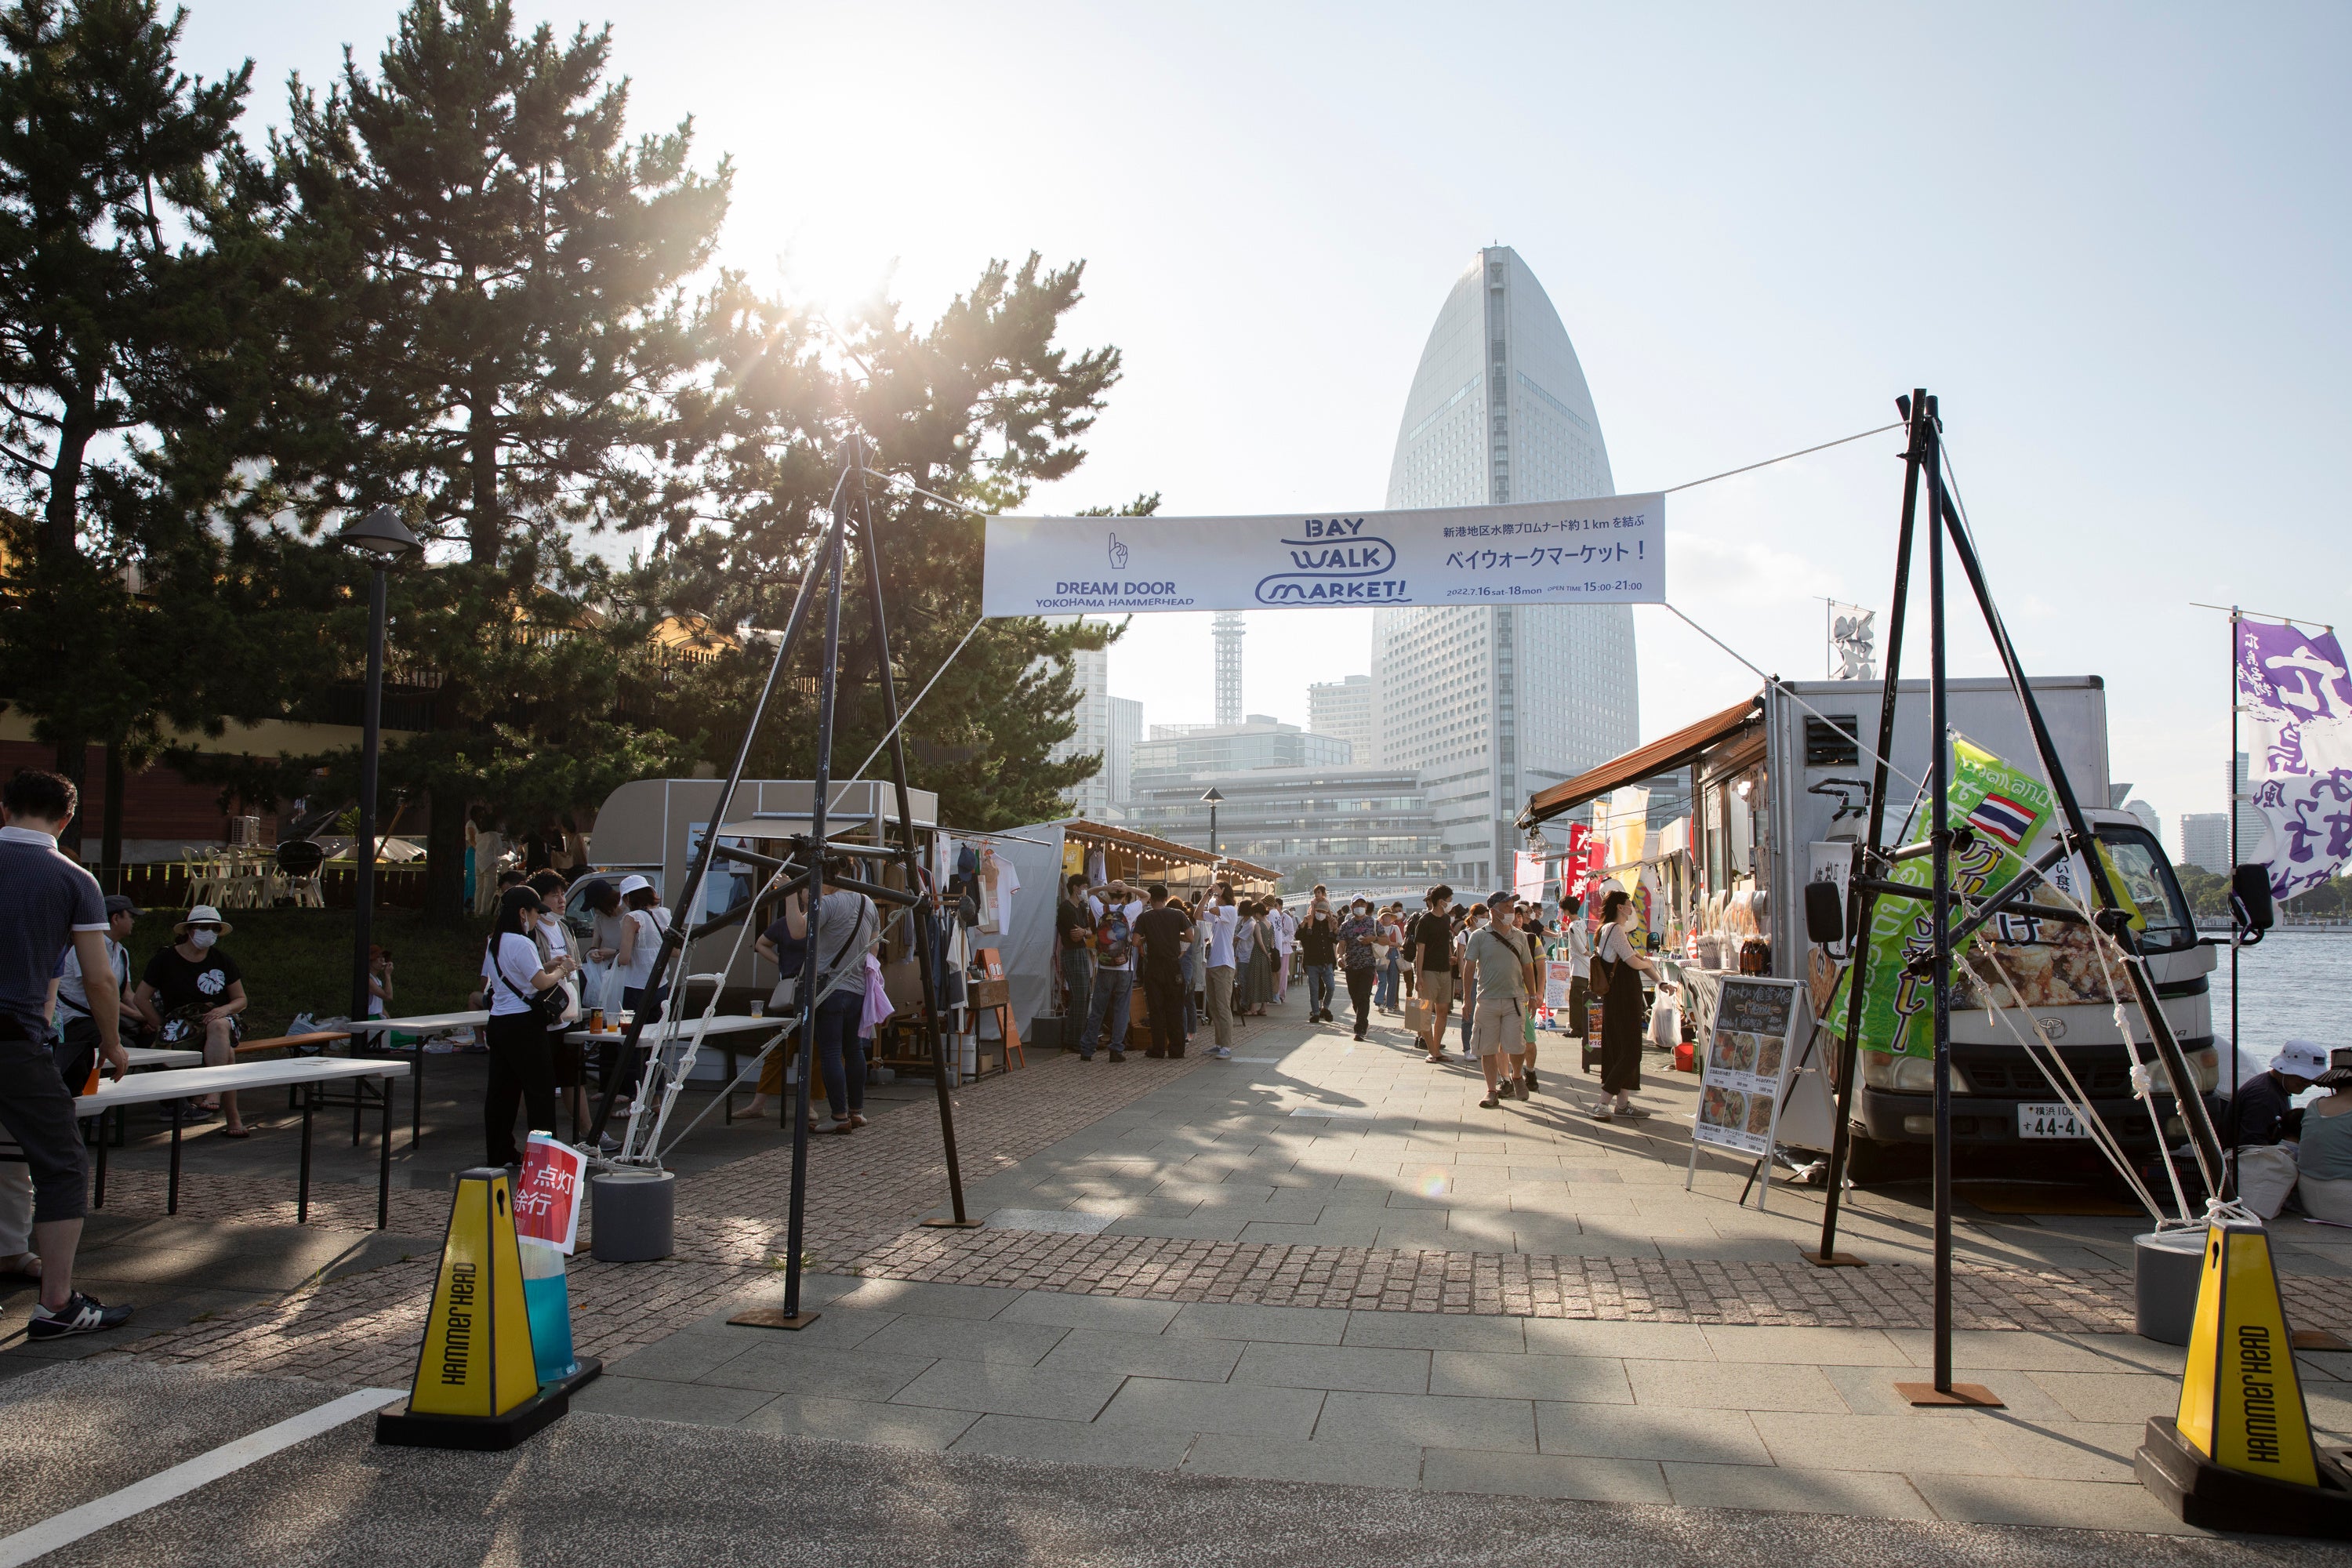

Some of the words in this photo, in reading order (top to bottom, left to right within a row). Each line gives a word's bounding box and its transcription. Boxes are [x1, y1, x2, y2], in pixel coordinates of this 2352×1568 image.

[1305, 517, 1364, 537] BAY
[1290, 547, 1381, 569] WALK
[1056, 582, 1118, 595] DREAM
[1124, 582, 1176, 595] DOOR
[1268, 580, 1406, 599] MARKET!
[1584, 580, 1642, 593] 15:00-21:00
[1036, 597, 1105, 608] YOKOHAMA
[1109, 597, 1194, 607] HAMMERHEAD
[2035, 1106, 2055, 1116] 横浜
[2023, 1122, 2031, 1131] す
